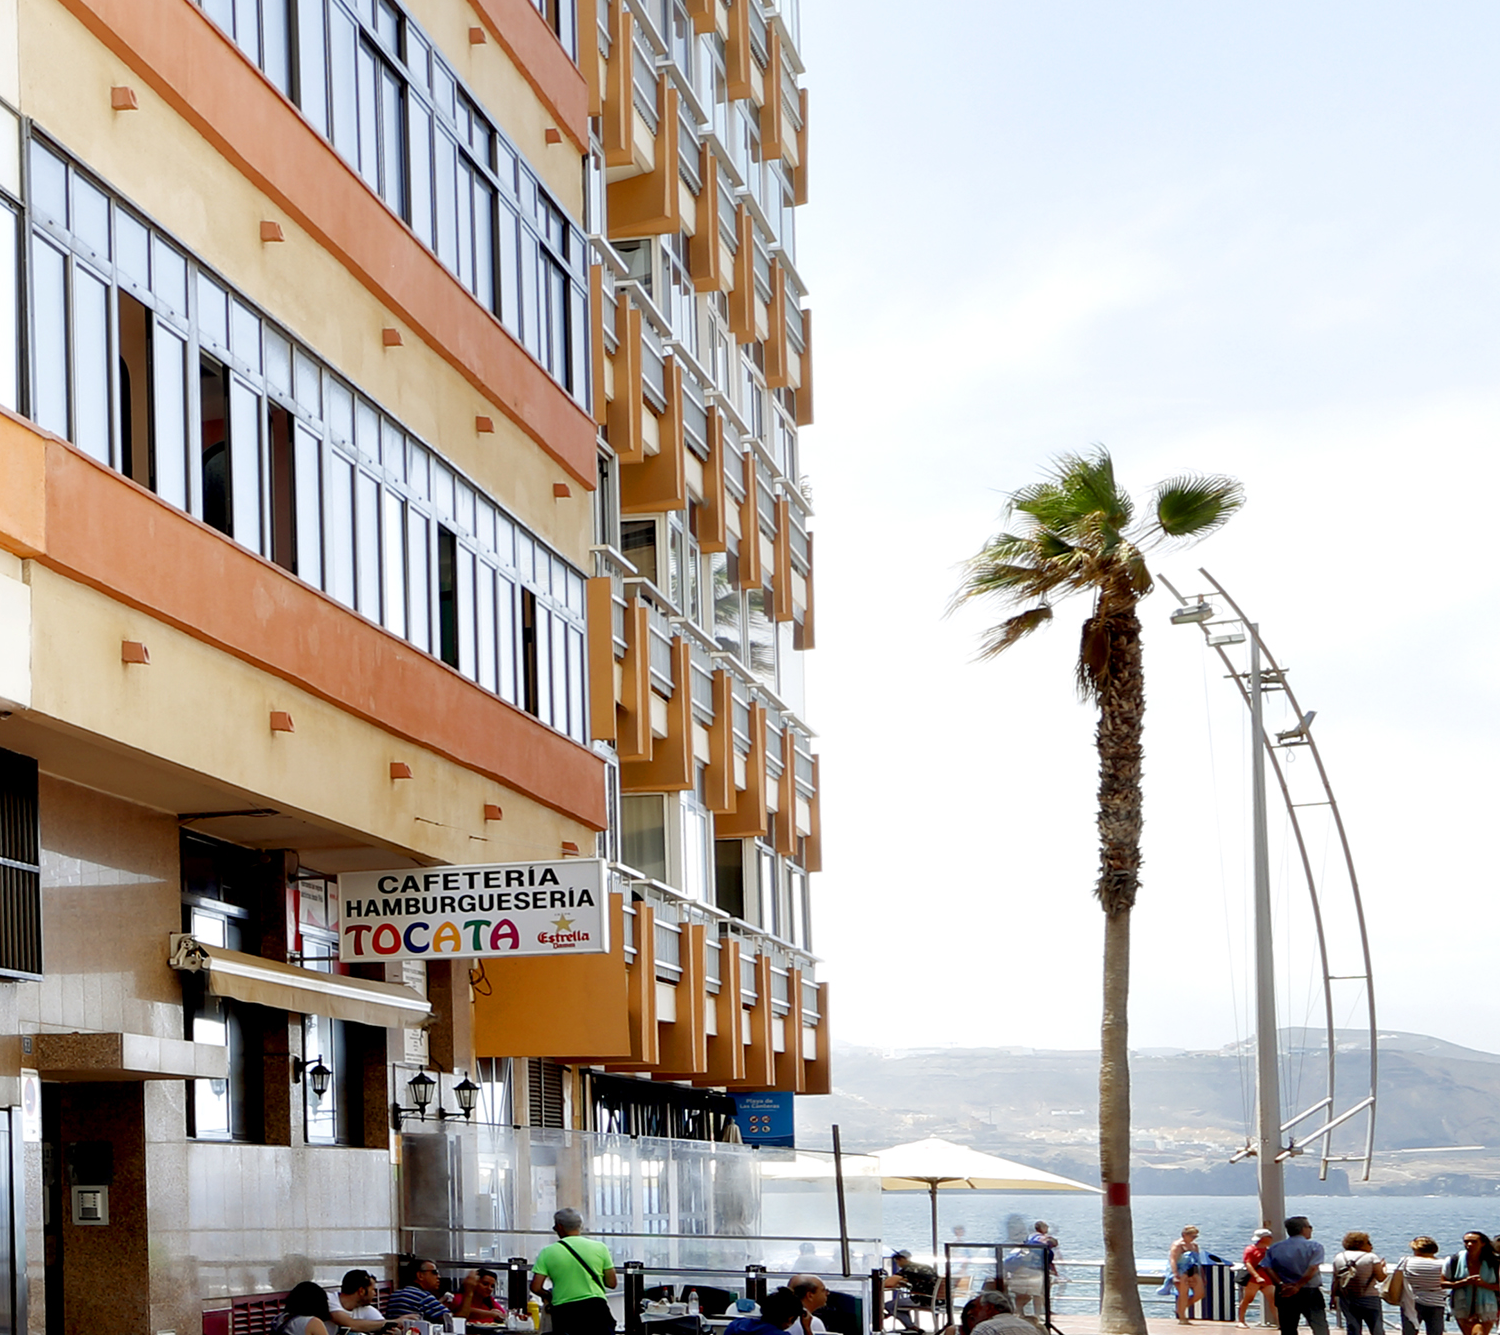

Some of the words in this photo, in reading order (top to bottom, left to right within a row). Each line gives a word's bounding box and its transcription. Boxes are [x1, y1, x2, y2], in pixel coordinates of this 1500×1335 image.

[377, 867, 560, 895] CAFETERÍA
[345, 887, 595, 918] HAMBURGUESERÍA
[344, 918, 520, 956] TOCATA
[537, 930, 591, 945] Estrella
